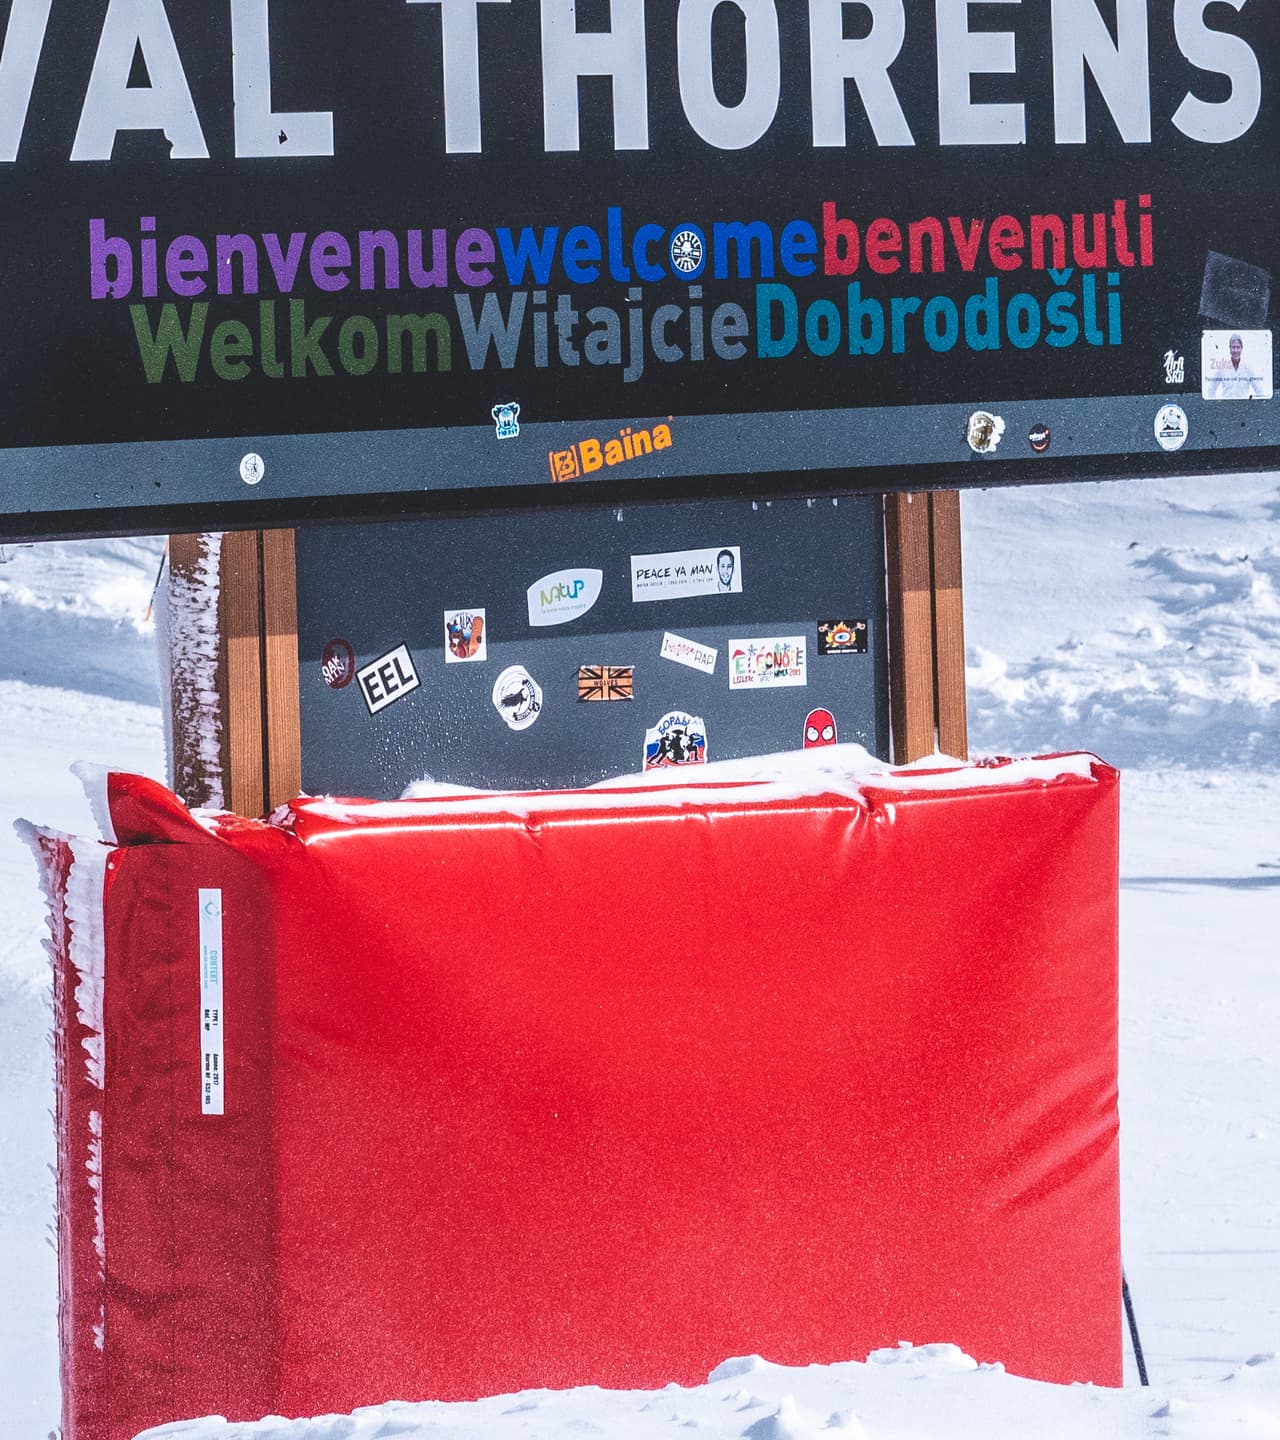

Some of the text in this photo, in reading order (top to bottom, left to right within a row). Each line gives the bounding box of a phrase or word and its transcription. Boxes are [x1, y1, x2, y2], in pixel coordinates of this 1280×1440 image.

[89, 194, 1154, 300] bienvenue welcome benvenuti
[128, 268, 1123, 384] Welkom Witajcie Dobrodošli
[579, 423, 673, 474] Baïna
[636, 563, 713, 580] PEACE YA MAN
[322, 655, 340, 678] OAK
[362, 657, 414, 706] EEL
